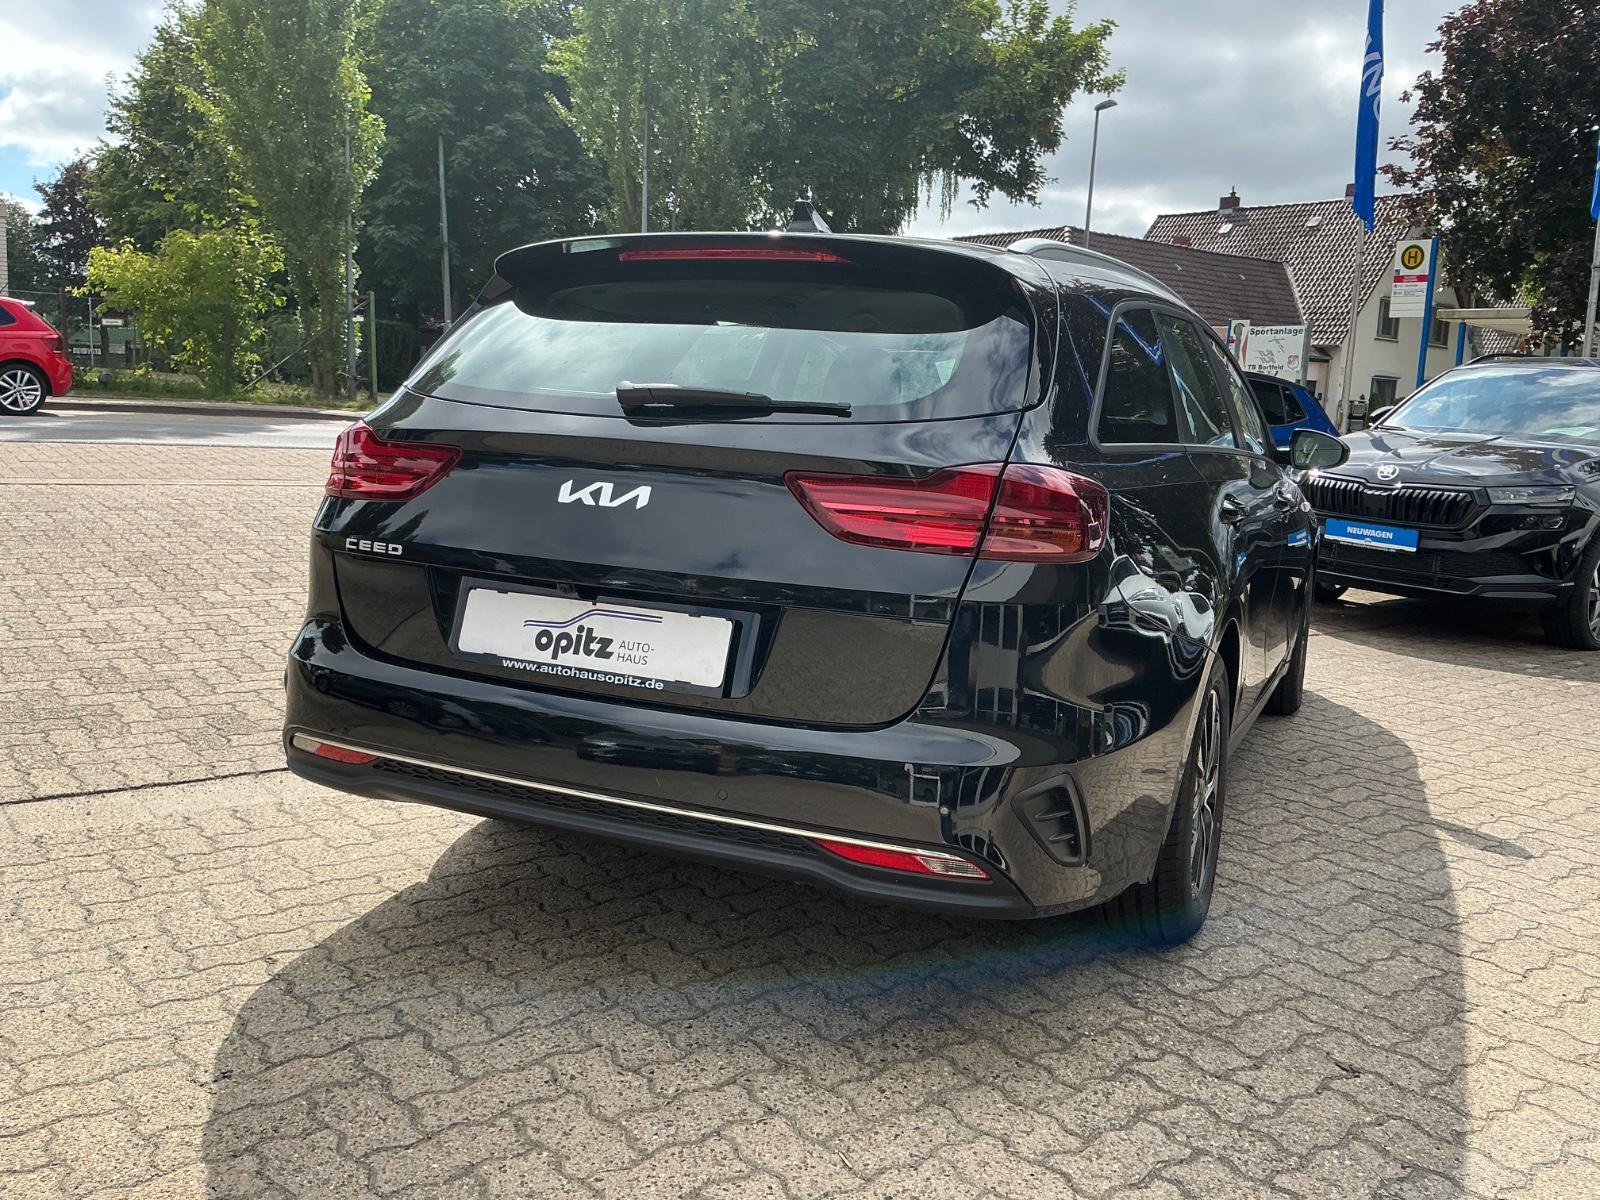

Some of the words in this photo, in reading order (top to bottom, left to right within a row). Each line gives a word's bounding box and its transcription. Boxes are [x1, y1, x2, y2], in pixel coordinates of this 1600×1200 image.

[1408, 250, 1418, 264] H
[1249, 327, 1304, 336] Sportanlage
[558, 480, 652, 510] KIA
[1346, 526, 1393, 540] NEUWAGEN
[345, 537, 402, 555] CEED
[535, 624, 614, 660] opitz
[618, 640, 655, 653] AUTO-
[616, 653, 648, 666] HAUS
[502, 658, 664, 690] www.autohausopitz.de
